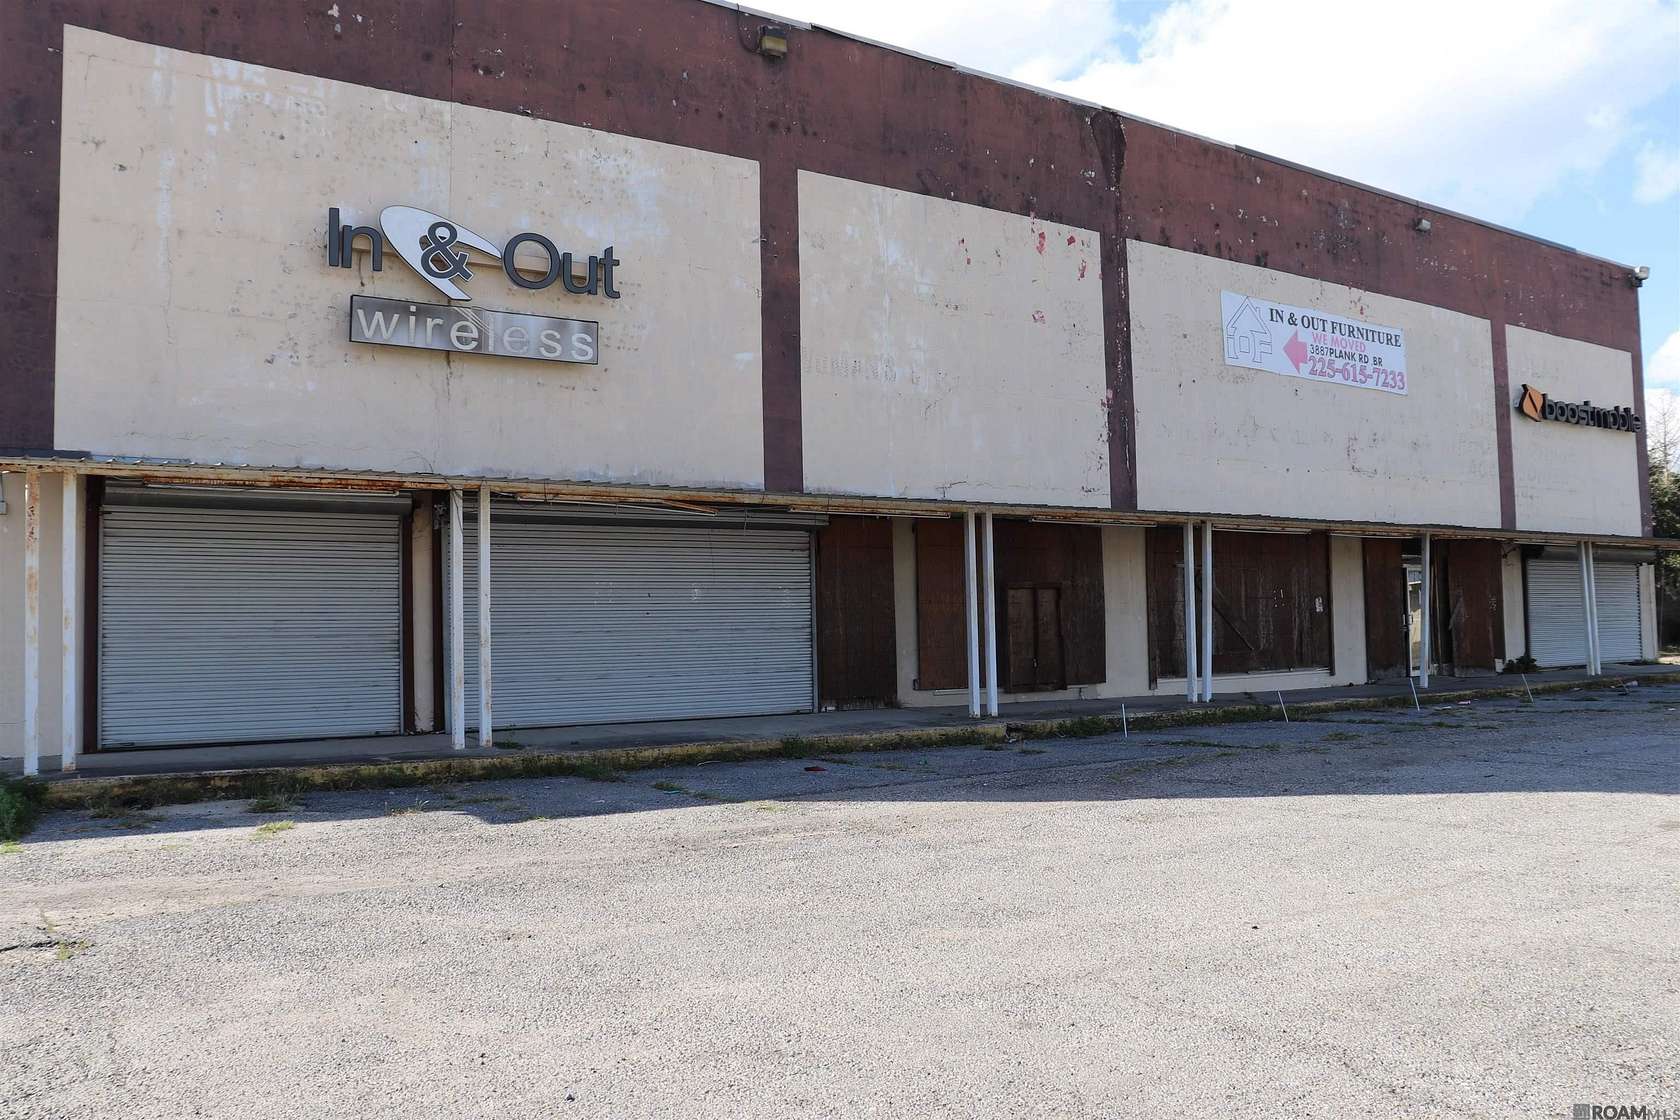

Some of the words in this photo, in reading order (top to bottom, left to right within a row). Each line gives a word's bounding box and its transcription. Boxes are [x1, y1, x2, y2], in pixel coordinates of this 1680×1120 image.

[328, 207, 383, 272] In
[420, 221, 474, 282] &
[503, 232, 621, 299] Out
[357, 305, 594, 361] wireless
[1269, 308, 1284, 324] IN
[1288, 312, 1298, 326] &
[1301, 315, 1328, 332] OUT
[1330, 320, 1401, 347] FURNITURE
[1312, 332, 1328, 345] WE
[1331, 335, 1366, 352] MOVED
[1309, 356, 1405, 390] 225-615-7233
[1359, 354, 1369, 364] RD
